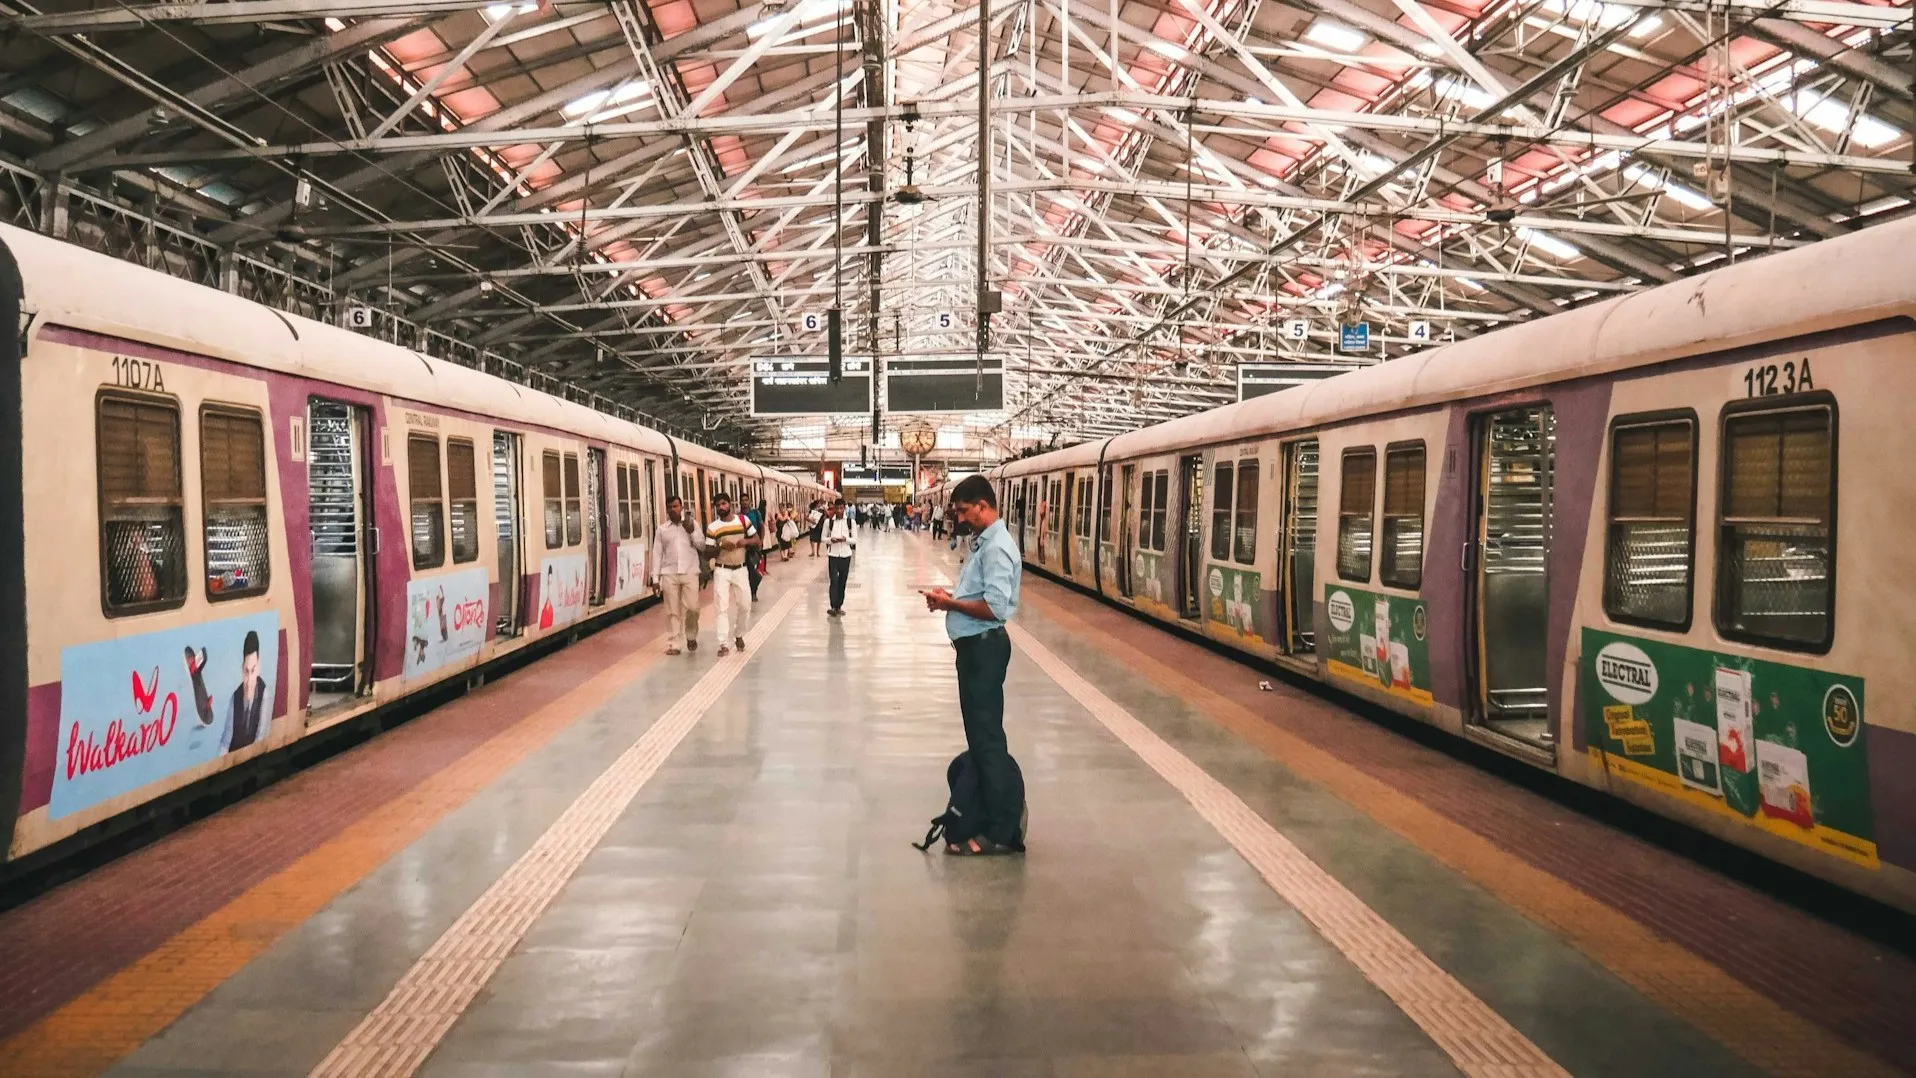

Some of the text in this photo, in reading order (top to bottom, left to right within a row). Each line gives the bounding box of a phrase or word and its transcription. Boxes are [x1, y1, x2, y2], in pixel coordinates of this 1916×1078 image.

[354, 311, 364, 324] 6
[806, 315, 817, 329] 6
[940, 314, 950, 328] 5
[1294, 323, 1304, 337] 5
[1414, 325, 1426, 338] 4
[112, 356, 165, 392] 1107A
[1601, 660, 1652, 688] ELECTRAL
[1833, 704, 1848, 723] 50
